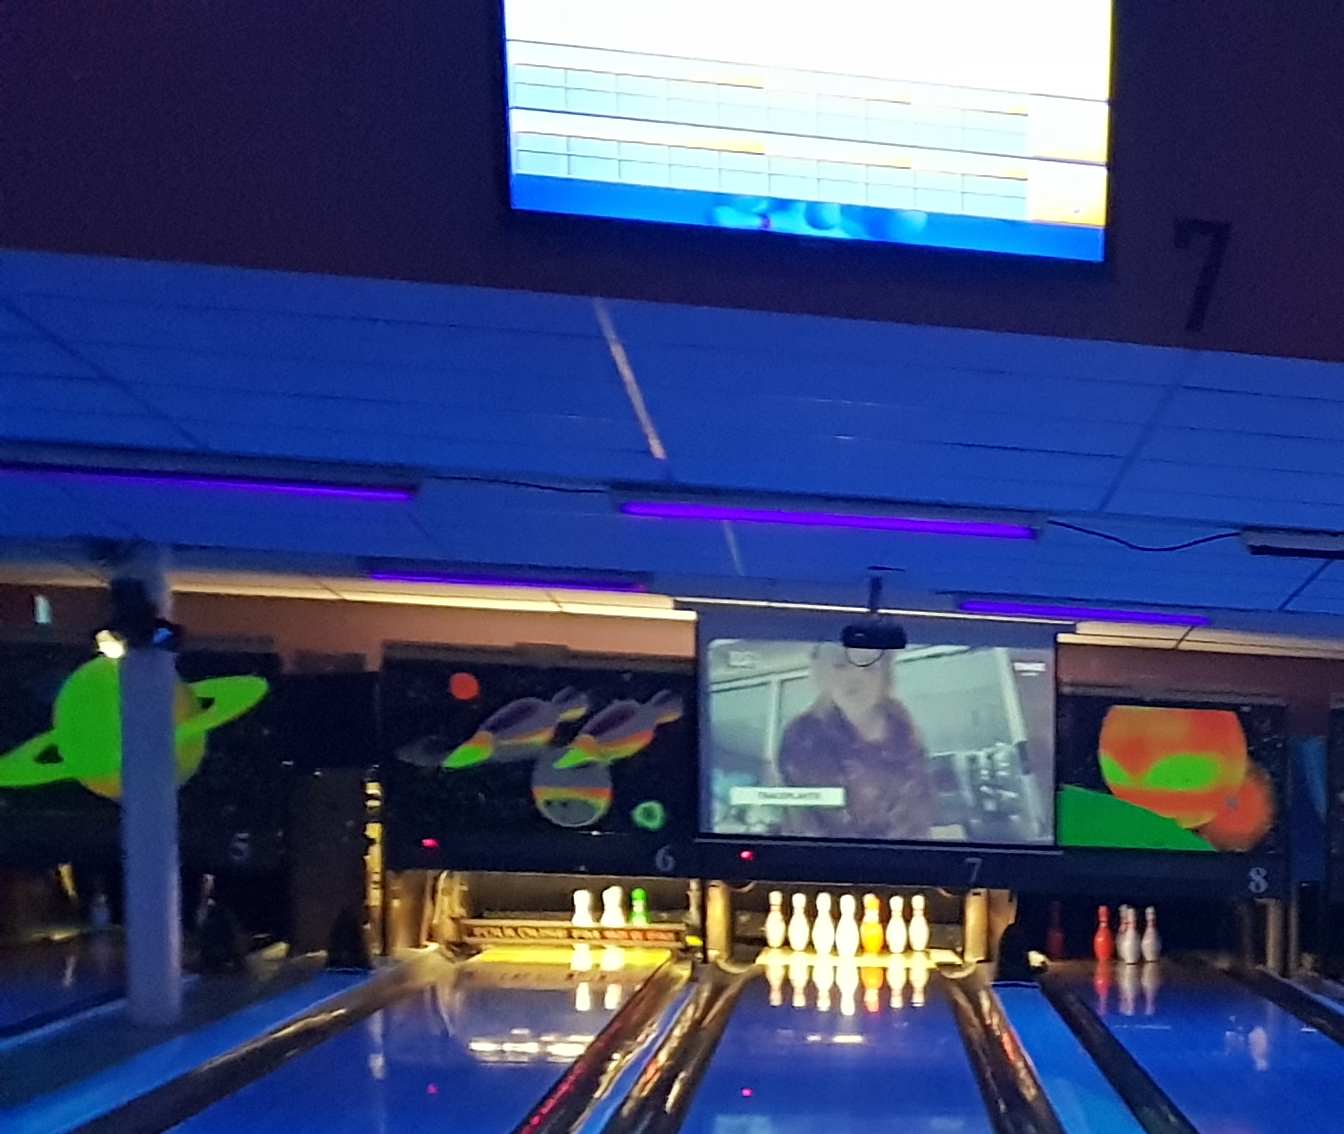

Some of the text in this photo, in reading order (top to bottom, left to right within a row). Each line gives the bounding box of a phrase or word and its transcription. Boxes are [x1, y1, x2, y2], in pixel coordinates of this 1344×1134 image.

[1174, 219, 1232, 332] 7
[655, 845, 676, 872] 6
[965, 857, 983, 885] 7
[1248, 866, 1269, 893] 8
